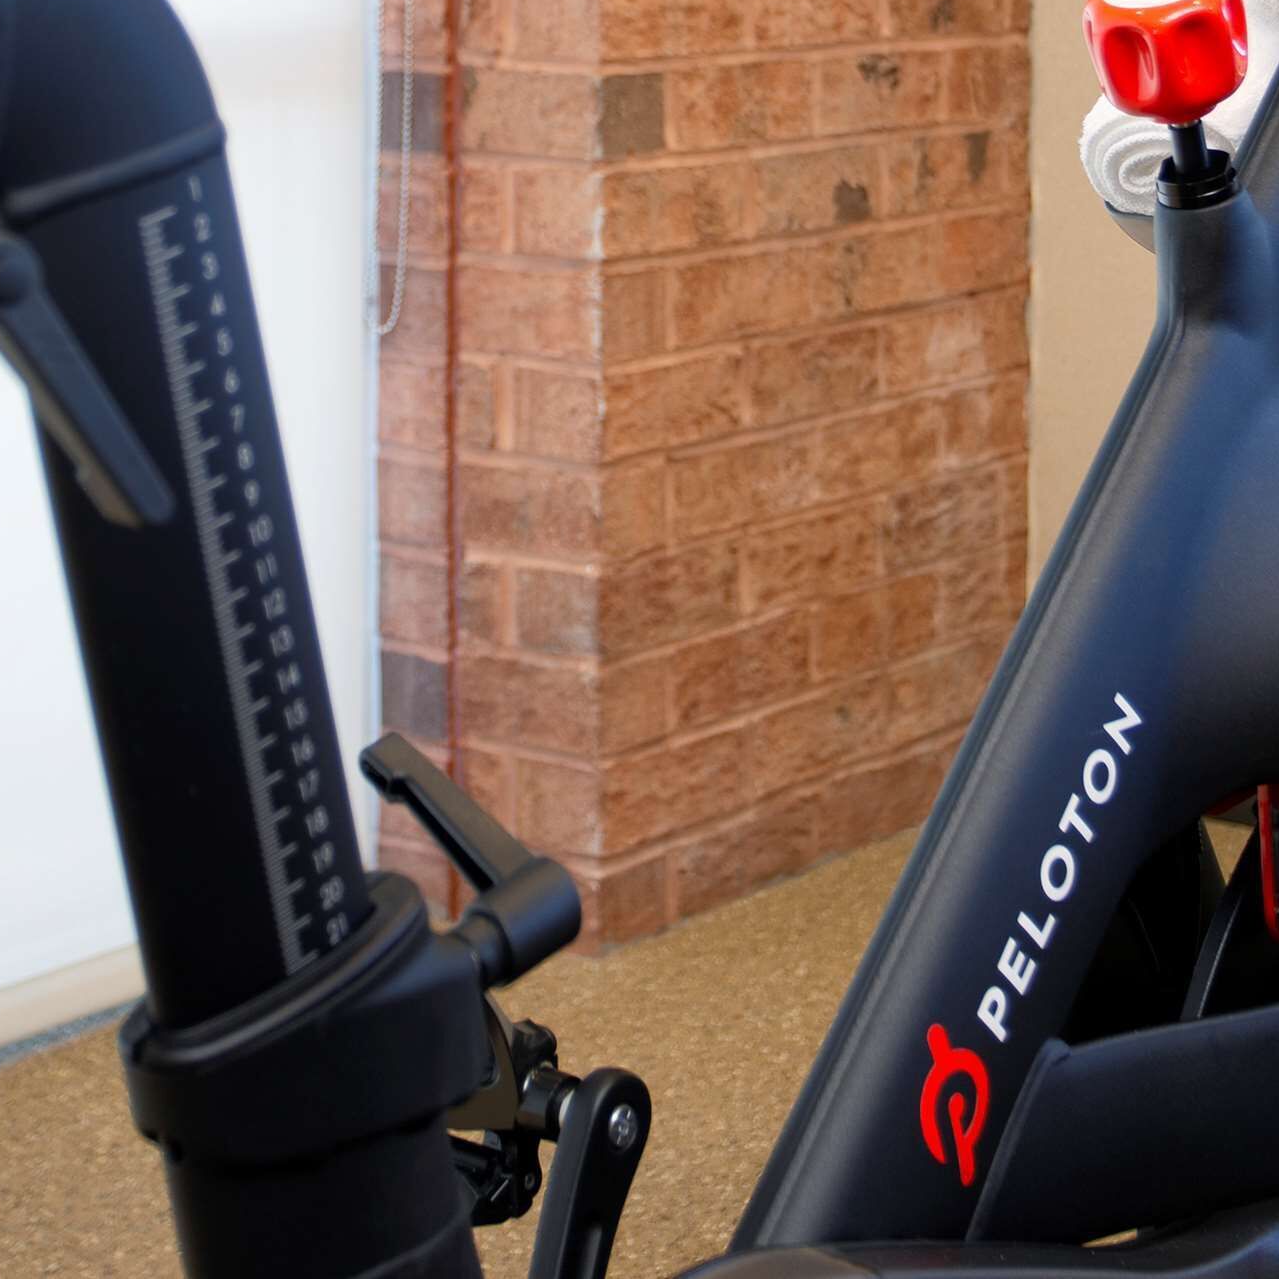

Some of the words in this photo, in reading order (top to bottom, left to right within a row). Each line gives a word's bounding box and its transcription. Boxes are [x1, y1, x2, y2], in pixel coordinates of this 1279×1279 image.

[189, 176, 202, 201] 1
[194, 213, 210, 242] 2
[201, 252, 218, 280] 3
[210, 293, 226, 316] 4
[217, 327, 233, 356] 5
[224, 367, 240, 394] 6
[230, 404, 245, 433] 7
[237, 442, 254, 469] 8
[244, 480, 260, 507] 9
[248, 513, 273, 547] 10
[256, 553, 277, 584] 11
[262, 588, 286, 620] 12
[271, 624, 295, 656] 13
[277, 663, 301, 694] 14
[284, 697, 307, 730] 15
[291, 733, 315, 767] 16
[298, 769, 319, 802] 17
[305, 805, 329, 838] 18
[976, 691, 1144, 1044] PELOTON
